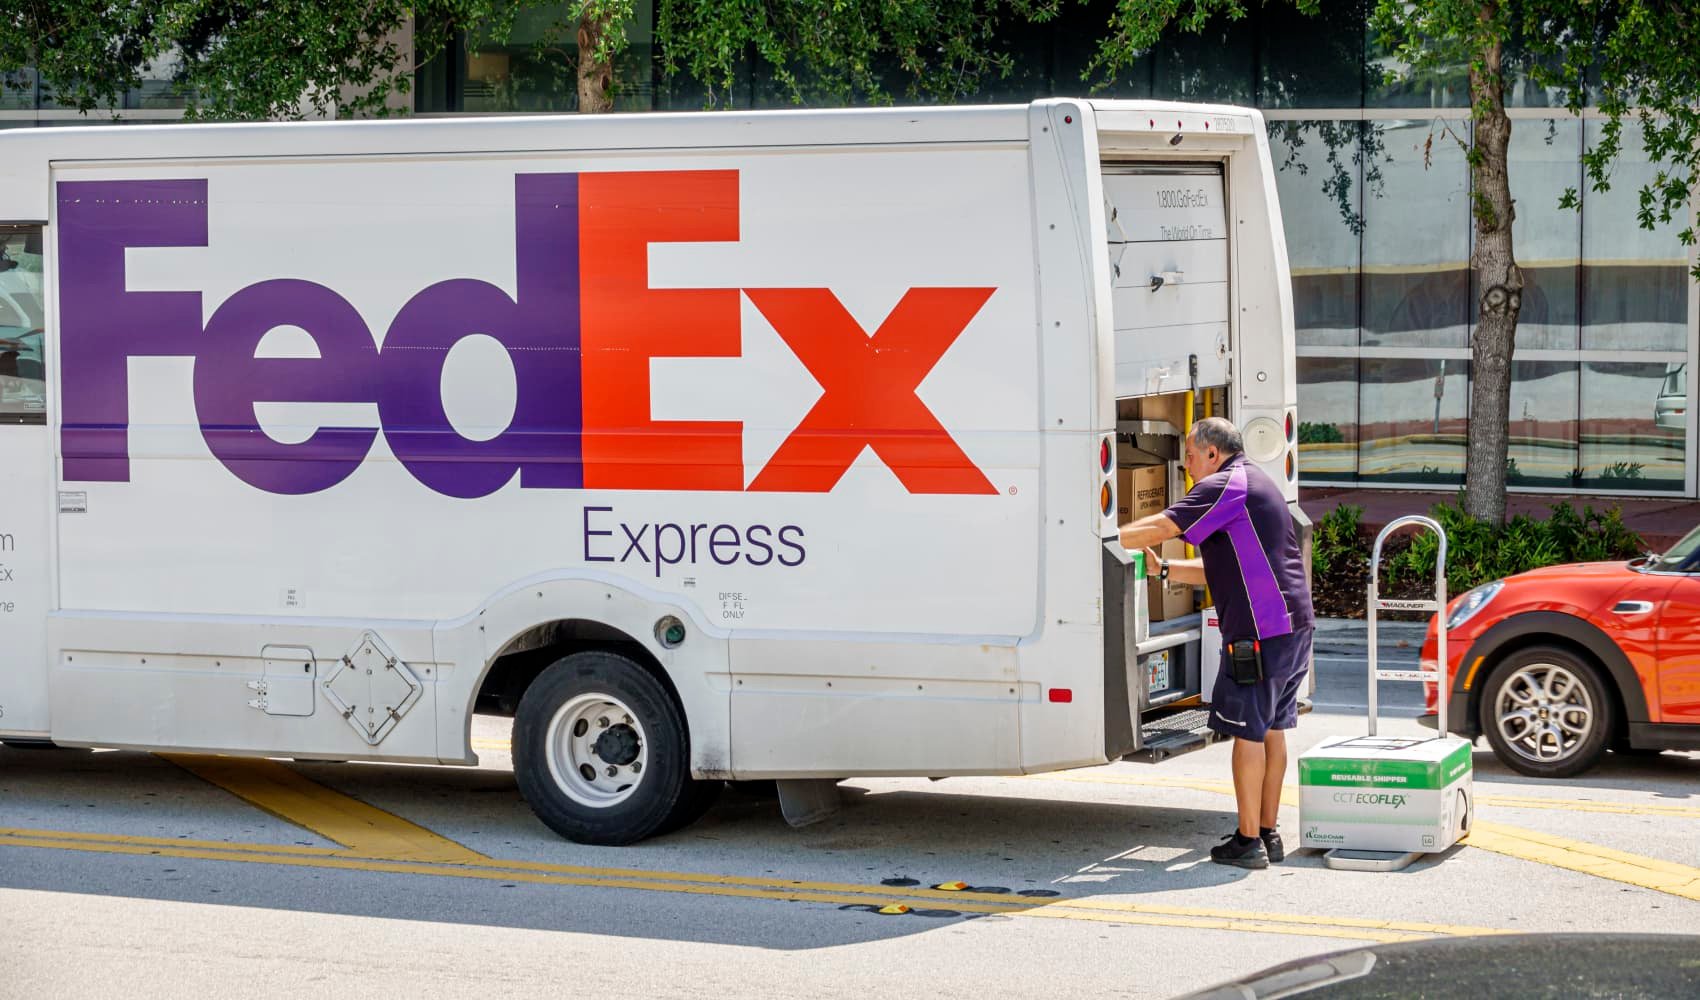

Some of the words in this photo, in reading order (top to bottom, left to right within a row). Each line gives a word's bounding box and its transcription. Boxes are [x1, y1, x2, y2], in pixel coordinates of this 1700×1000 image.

[57, 169, 1000, 499] FedEx
[583, 506, 806, 577] Express
[722, 611, 745, 619] ONLY
[1331, 774, 1371, 783] REUSABLE
[1372, 775, 1408, 784] SHIPPER
[1356, 792, 1407, 809] ECOFLEX
